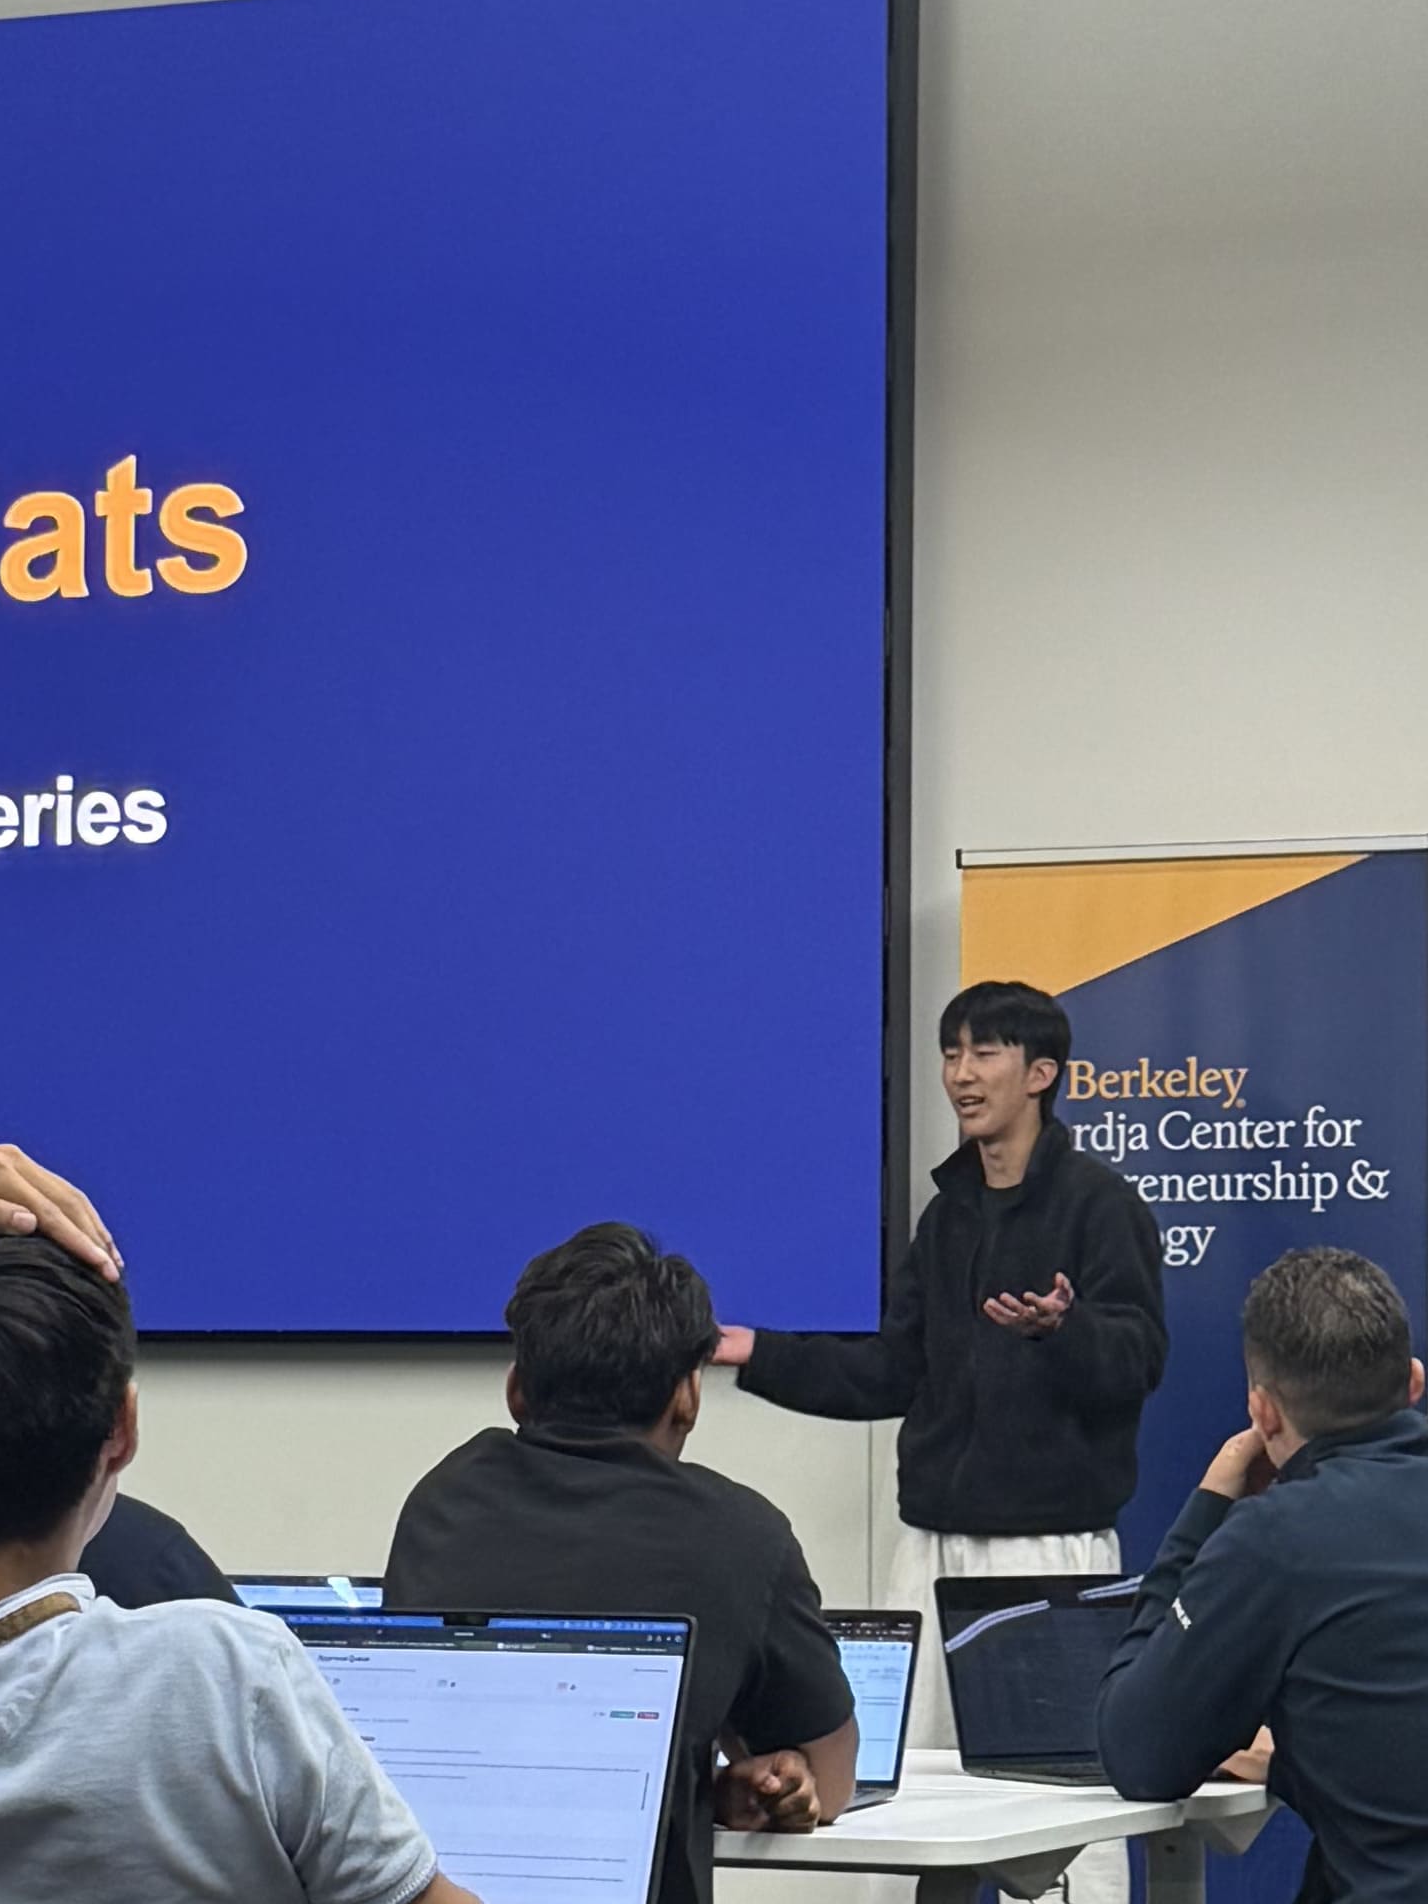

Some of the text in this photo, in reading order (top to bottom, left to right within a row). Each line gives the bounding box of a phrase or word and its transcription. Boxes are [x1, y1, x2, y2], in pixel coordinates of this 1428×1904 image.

[1065, 1056, 1249, 1109] Berkeley
[1071, 1104, 1362, 1163] rdja Center for
[1123, 1158, 1391, 1213] eneurship &
